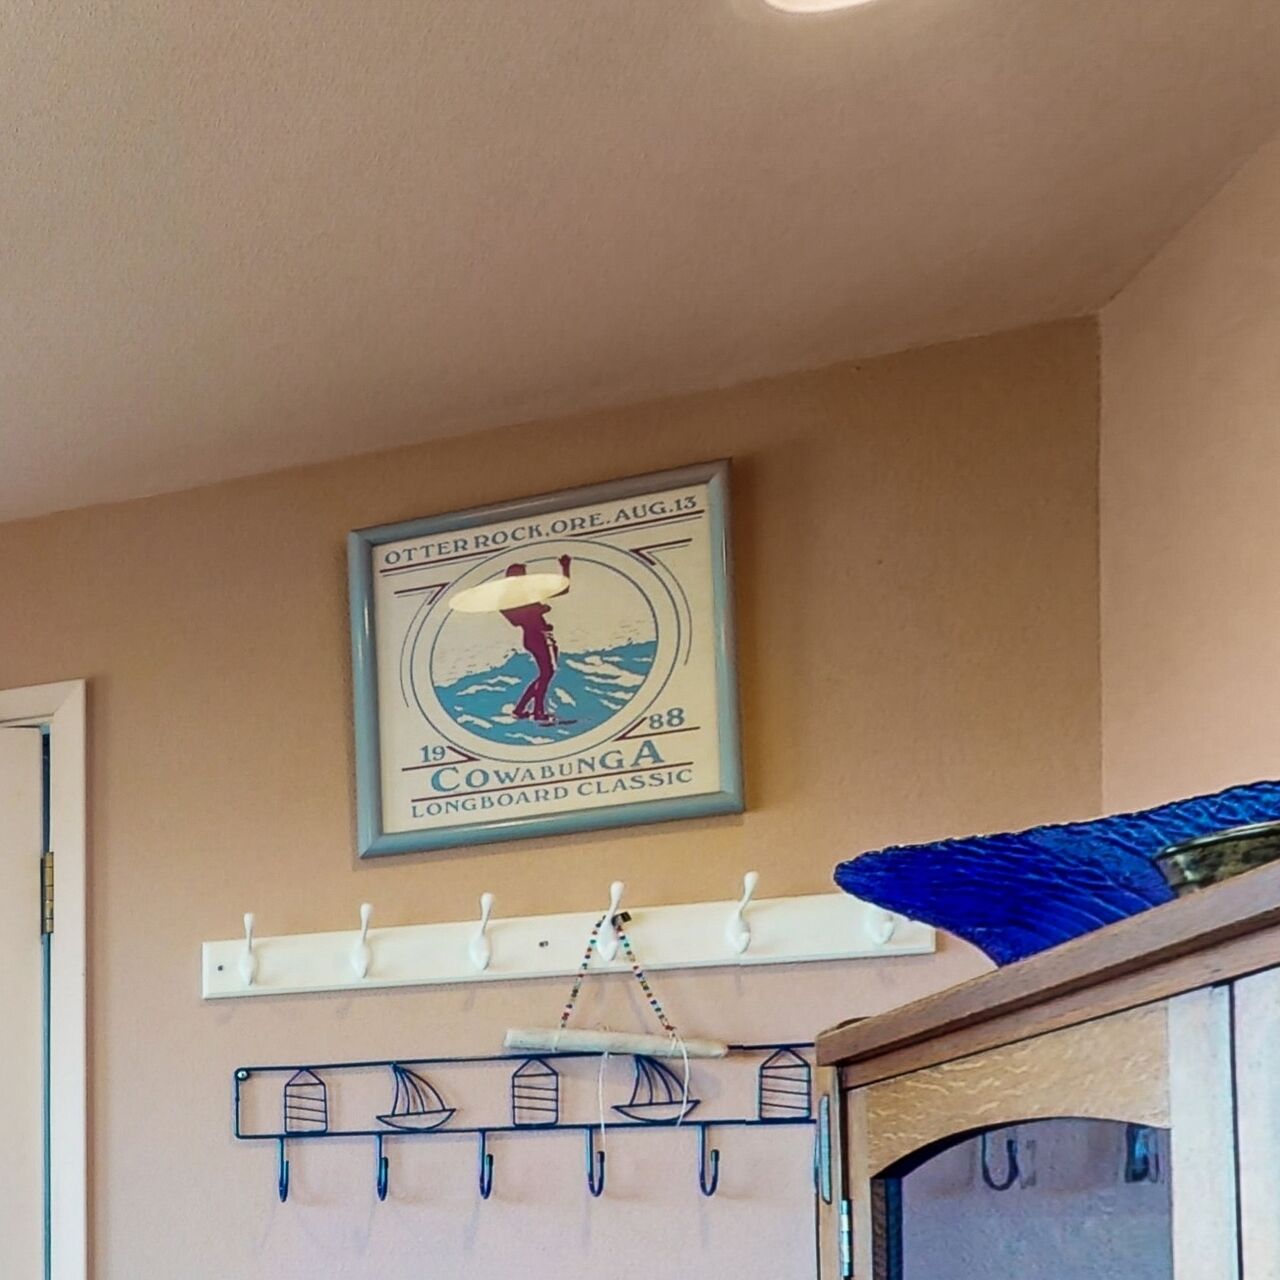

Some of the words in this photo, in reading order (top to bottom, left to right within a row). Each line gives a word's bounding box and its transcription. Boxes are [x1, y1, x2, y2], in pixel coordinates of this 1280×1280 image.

[383, 538, 469, 566] OTTER
[648, 707, 685, 731] 88
[419, 744, 446, 764] 19
[430, 739, 665, 793] COWABUNGA
[410, 778, 569, 819] LONGBOARD
[577, 768, 693, 797] CLASSIC
